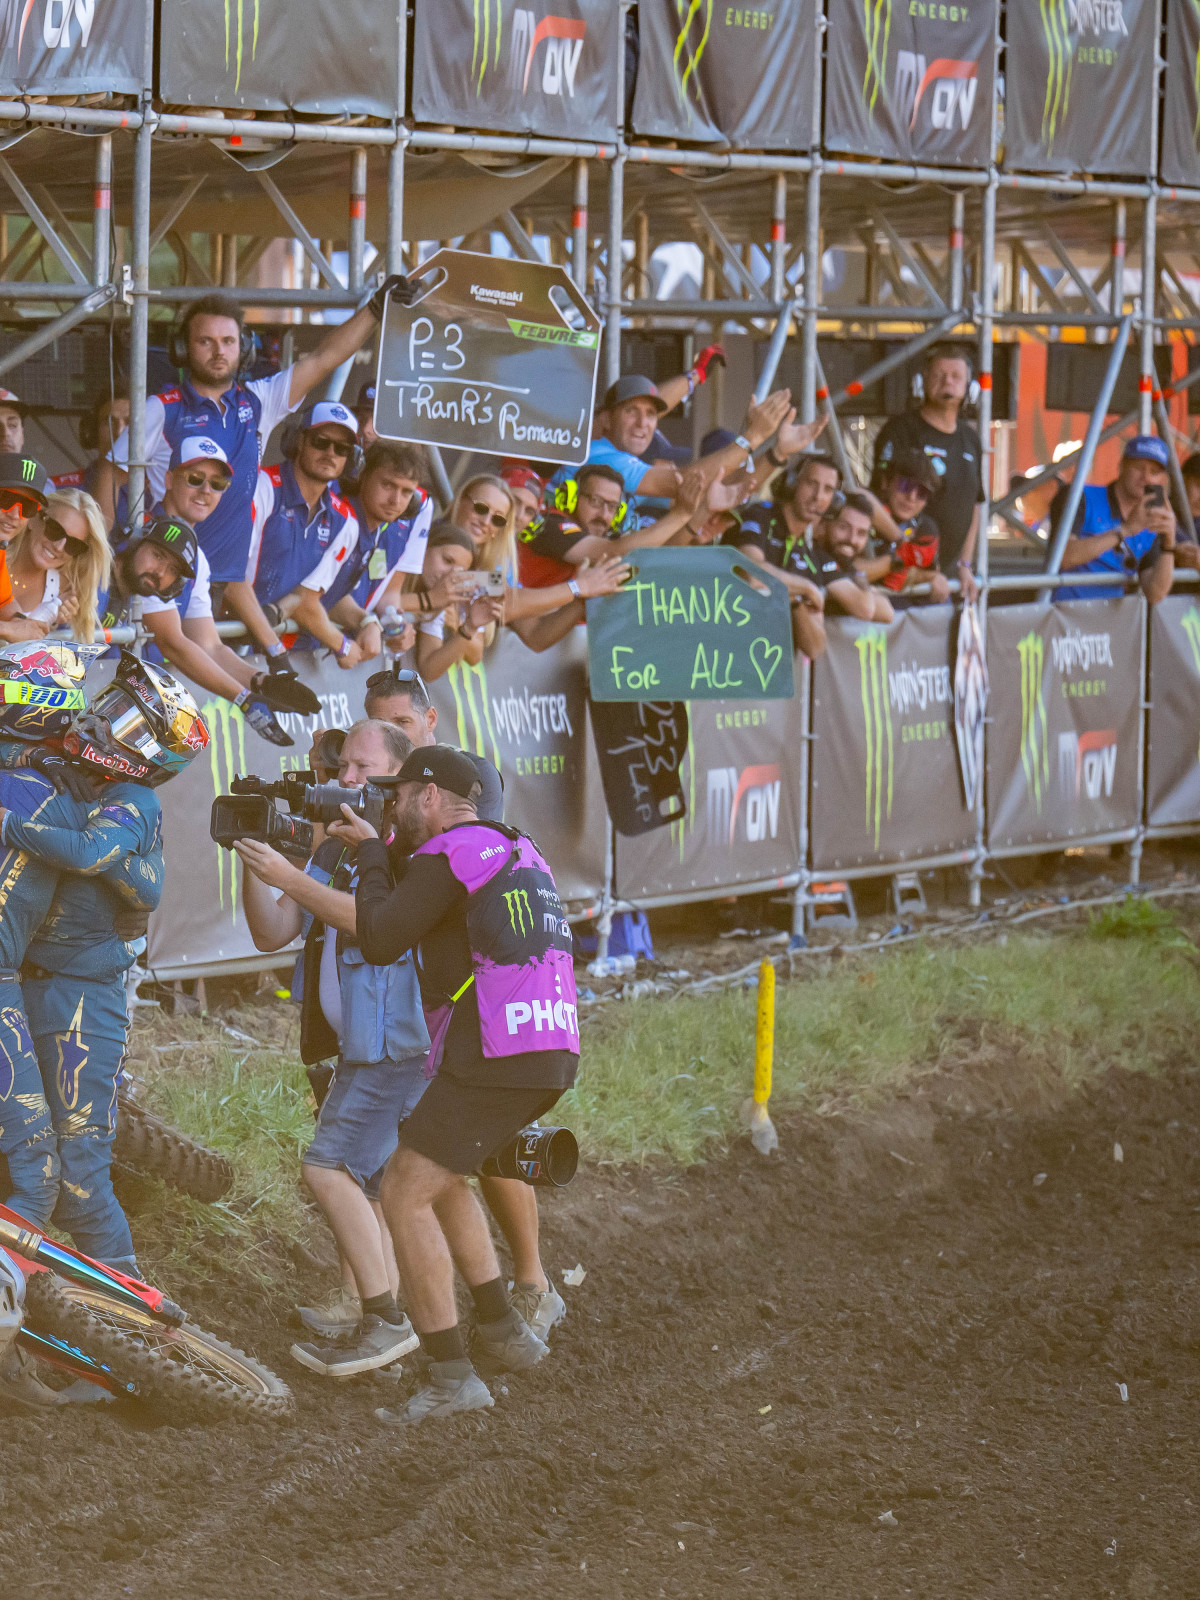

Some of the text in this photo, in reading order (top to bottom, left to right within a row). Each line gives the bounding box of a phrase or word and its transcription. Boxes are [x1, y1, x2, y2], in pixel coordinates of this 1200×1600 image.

[725, 8, 773, 30] ENERGY
[470, 284, 523, 302] Kawasaki
[519, 325, 596, 347] FEBVRE 3
[690, 642, 743, 690] ALL
[715, 709, 768, 730] ENERGY
[515, 755, 566, 776] ENERGY
[504, 998, 581, 1035] PHOT
